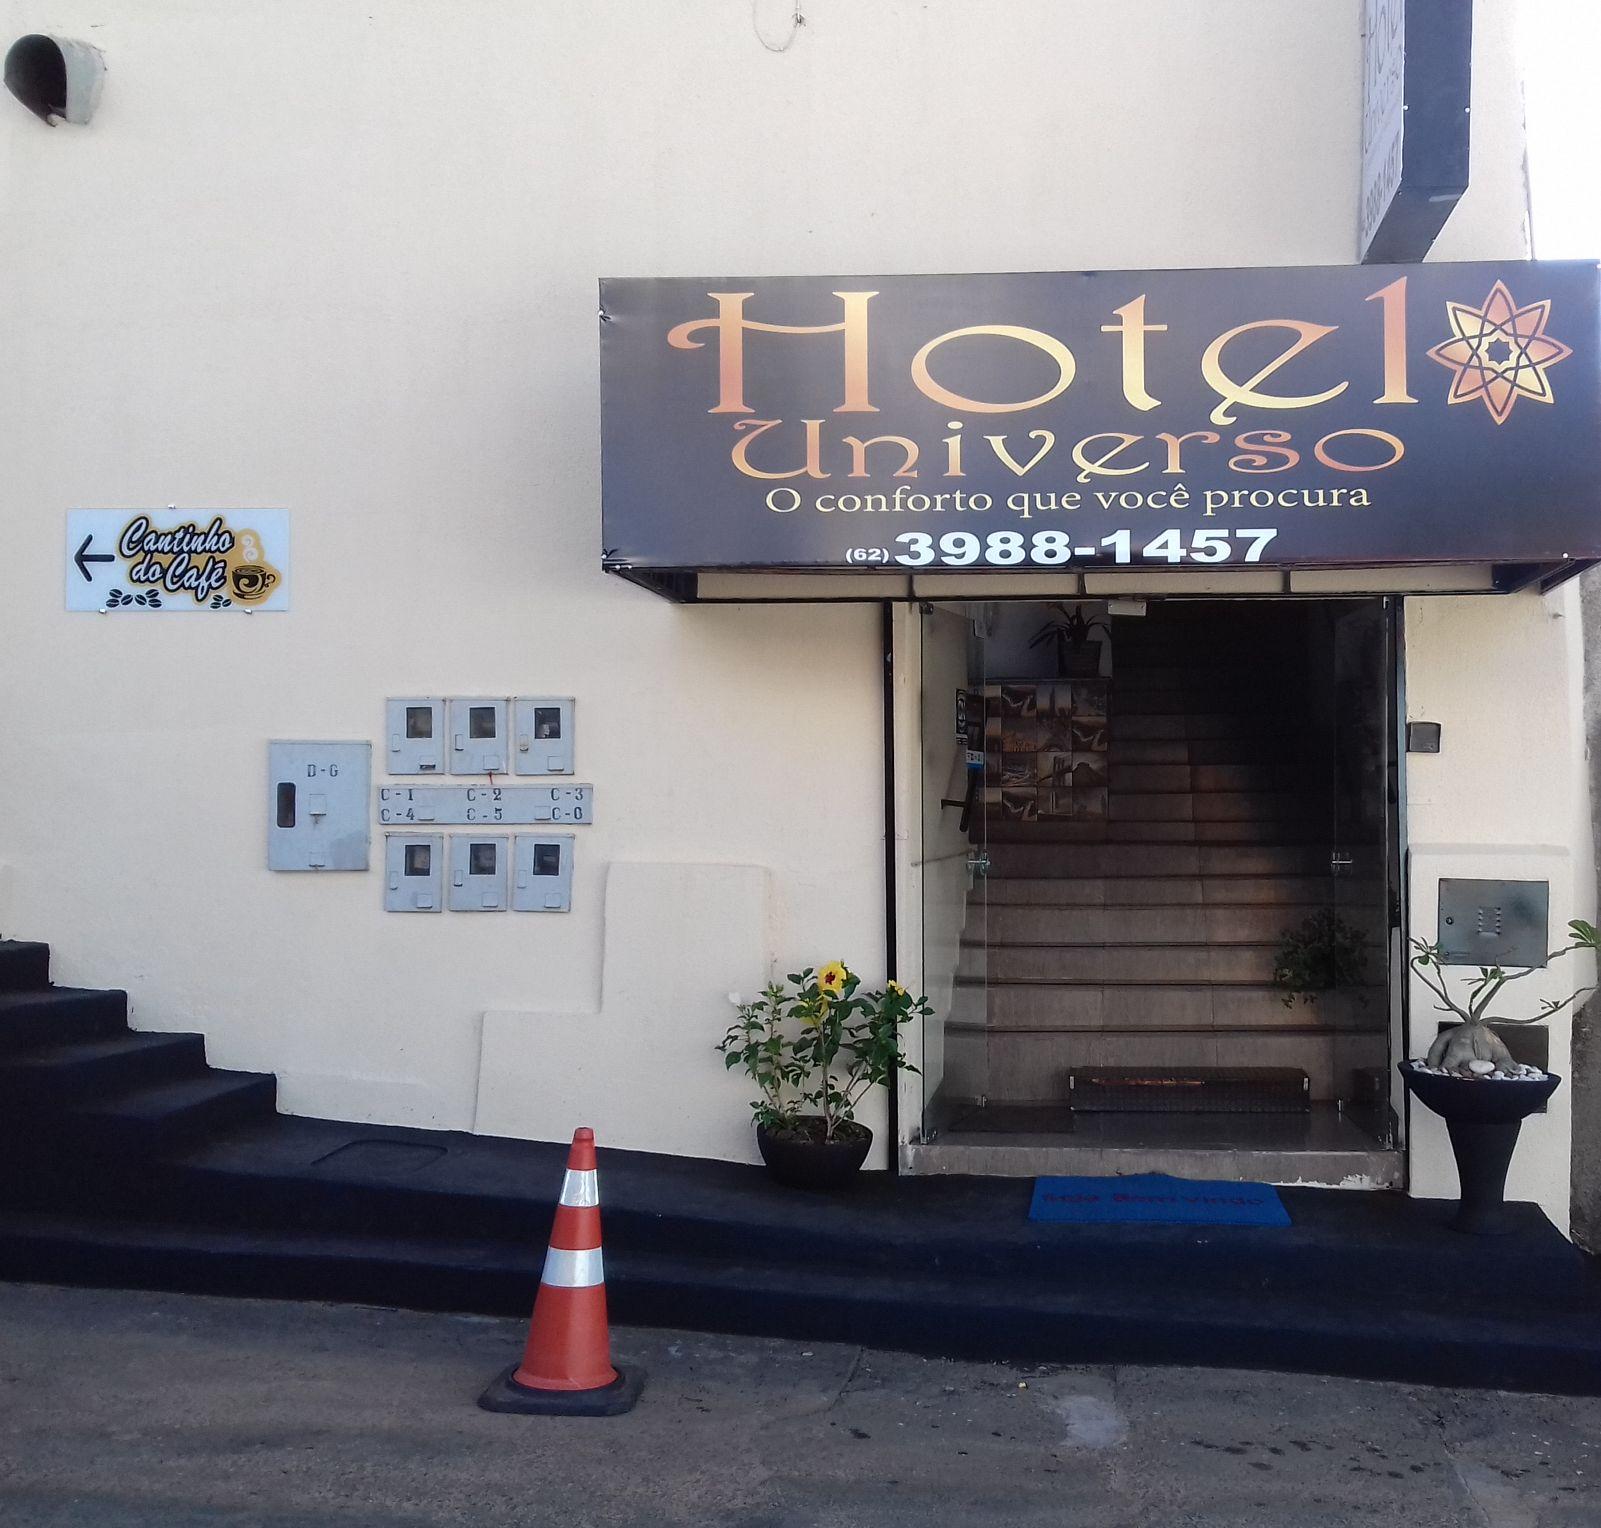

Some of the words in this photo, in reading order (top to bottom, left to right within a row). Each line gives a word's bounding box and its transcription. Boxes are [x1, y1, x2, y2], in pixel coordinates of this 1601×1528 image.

[667, 275, 1420, 426] Hotel
[731, 417, 1406, 484] Universo
[765, 487, 802, 513] O
[815, 484, 993, 513] conforto
[1005, 488, 1082, 519] que
[1093, 482, 1190, 510] você
[1202, 486, 1372, 517] procura
[119, 515, 236, 559] Cantinho
[845, 547, 890, 564] (62)
[894, 528, 1279, 565] 3988-1457
[130, 556, 162, 584] do
